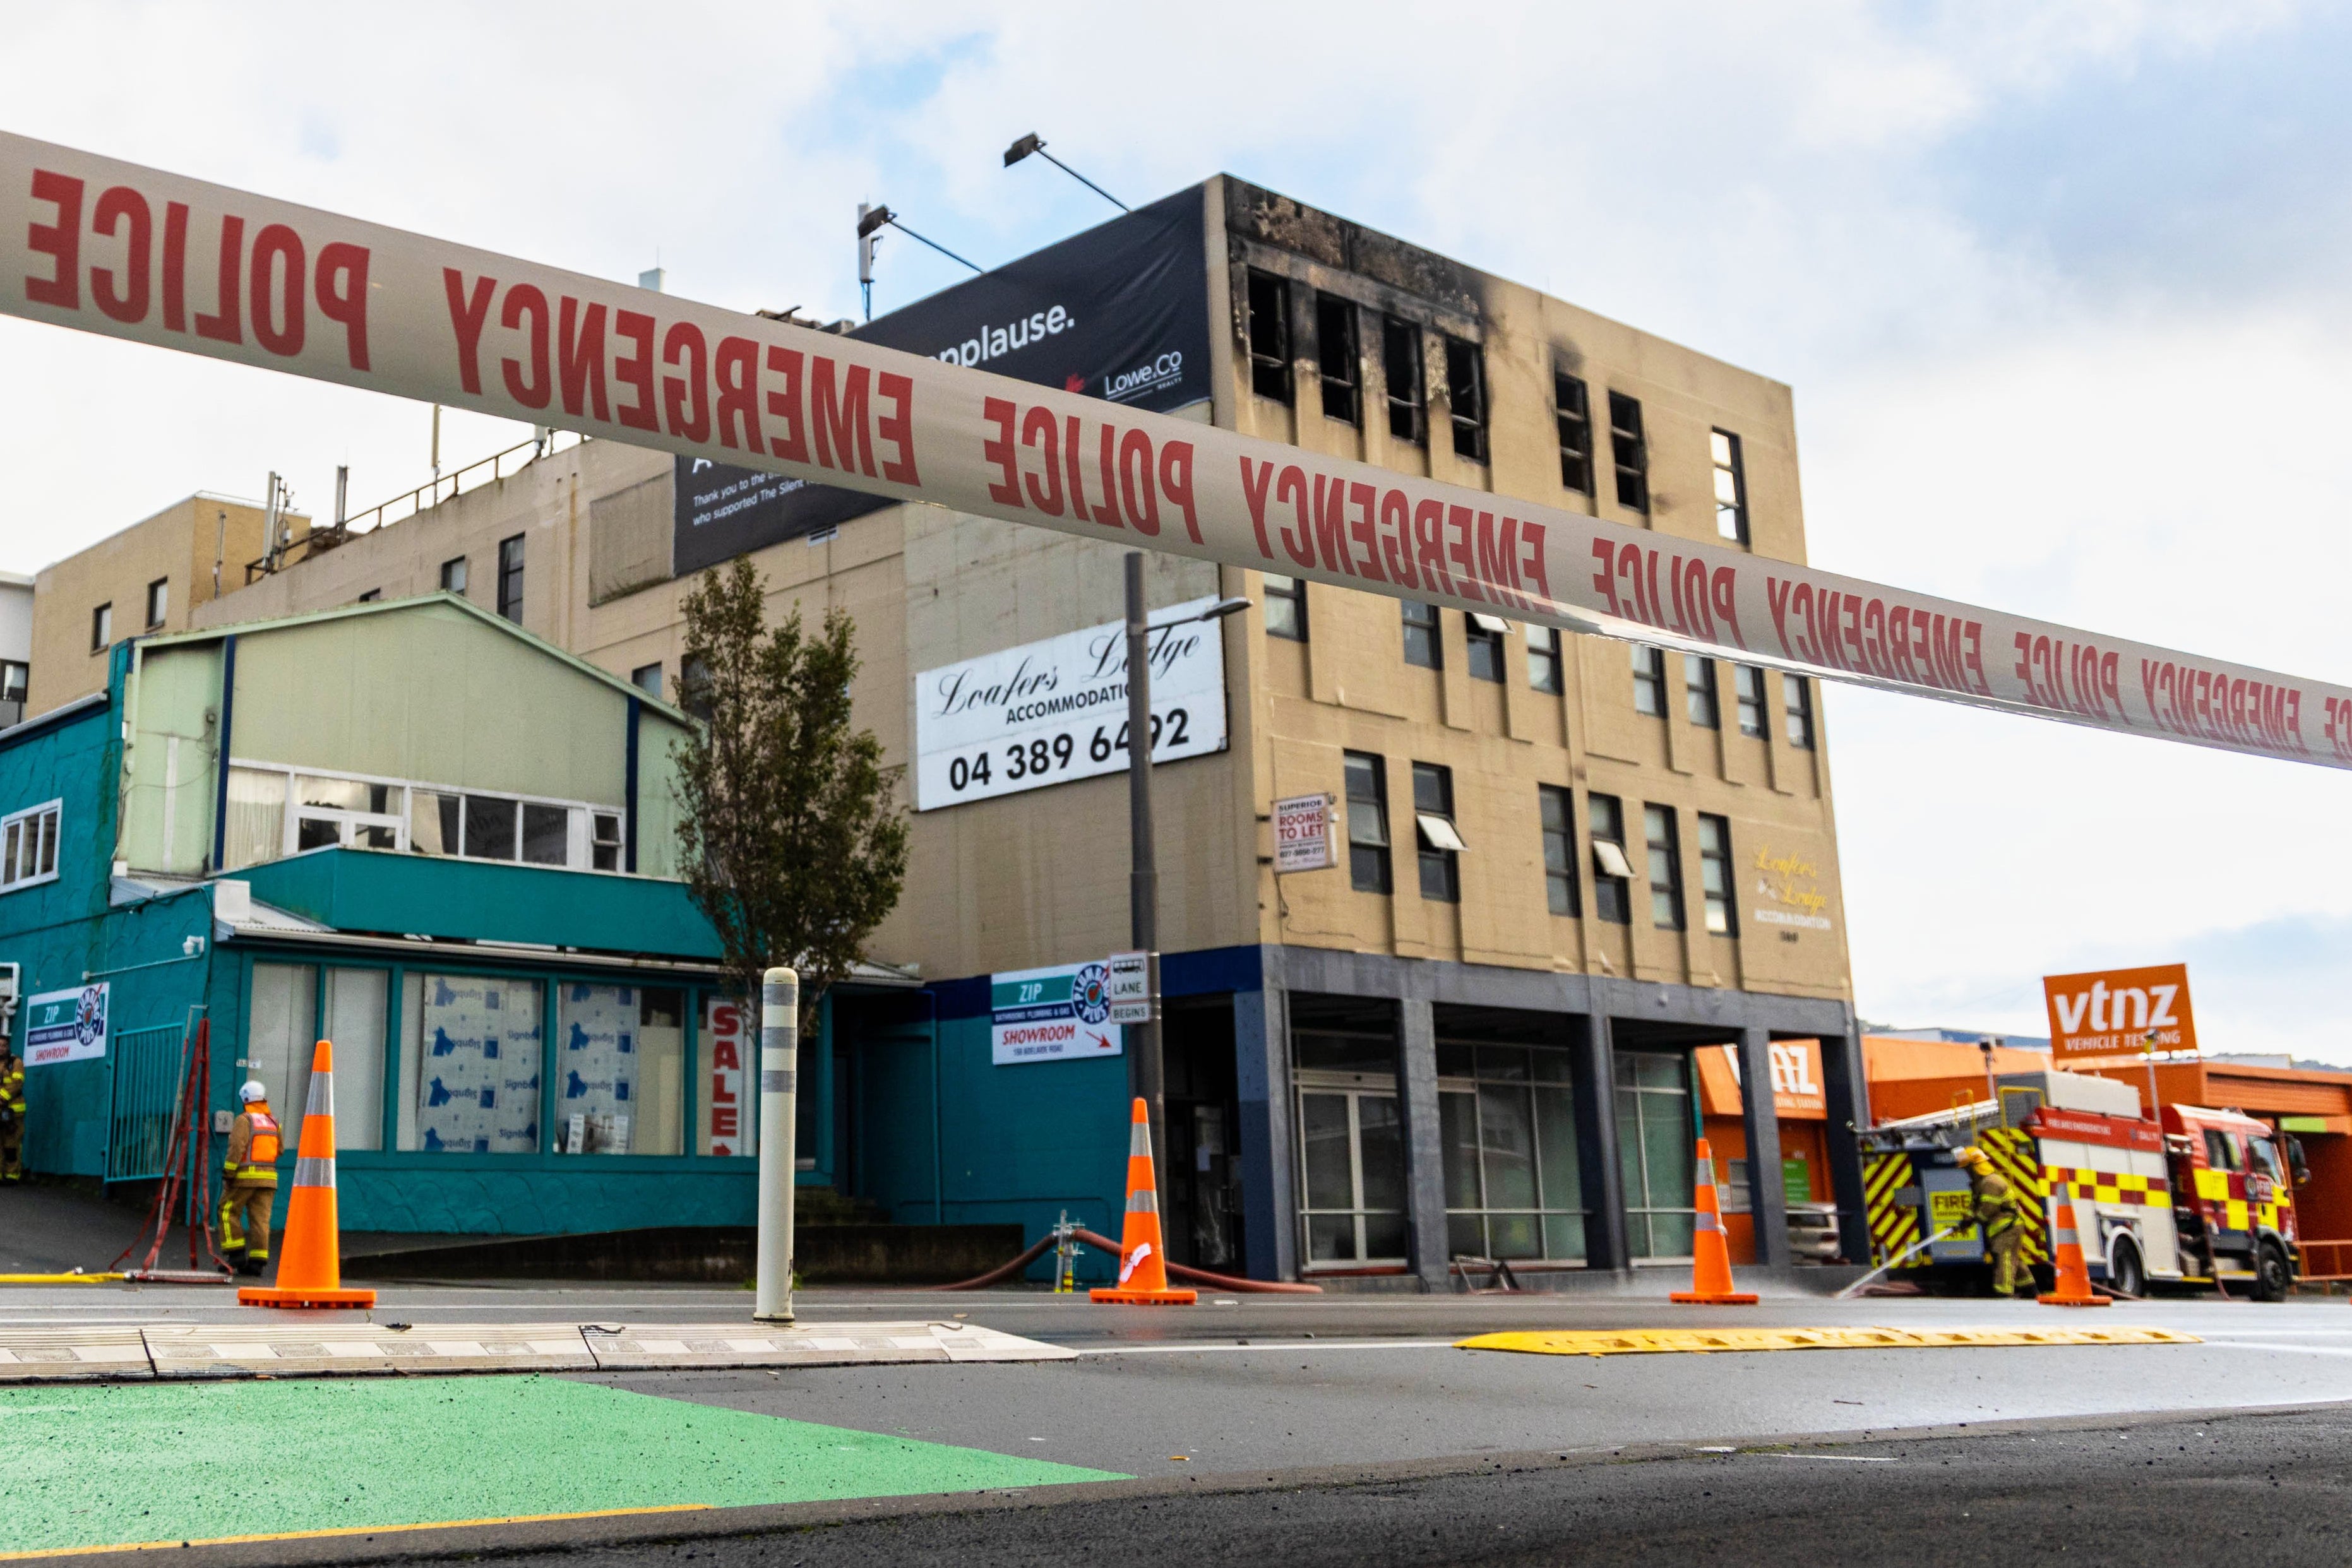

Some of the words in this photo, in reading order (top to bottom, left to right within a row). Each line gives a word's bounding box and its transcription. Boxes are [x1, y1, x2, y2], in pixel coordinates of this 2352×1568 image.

[928, 304, 1075, 367] plause.
[693, 489, 719, 506] Thank
[721, 482, 737, 500] you
[739, 478, 749, 490] to
[751, 473, 766, 487] the
[693, 509, 712, 526] who
[713, 493, 758, 521] supported
[760, 489, 777, 502] The
[779, 478, 804, 496] Silent
[931, 655, 1059, 720] Loafers
[1006, 682, 1131, 725] ACCOMMODATI
[950, 752, 992, 792] 04
[1006, 733, 1073, 780] 389
[1279, 800, 1322, 812] SUPERIOR
[1279, 811, 1323, 827] ROOMS
[1279, 828, 1298, 840] TO
[1301, 823, 1323, 838] LET
[1019, 983, 1043, 1003] ZIP
[1114, 982, 1142, 995] LANE
[44, 1005, 59, 1024] ZIP
[1113, 1007, 1146, 1019] BEGINS
[2055, 979, 2179, 1034] vtnz
[1003, 1024, 1075, 1046] SHOWROOM
[2064, 1034, 2118, 1051] VEHICLE
[2123, 1030, 2181, 1047] TESNG
[35, 1045, 69, 1062] SHOWROOM
[712, 1006, 740, 1137] SALE
[1934, 1194, 1971, 1210] FIRE
